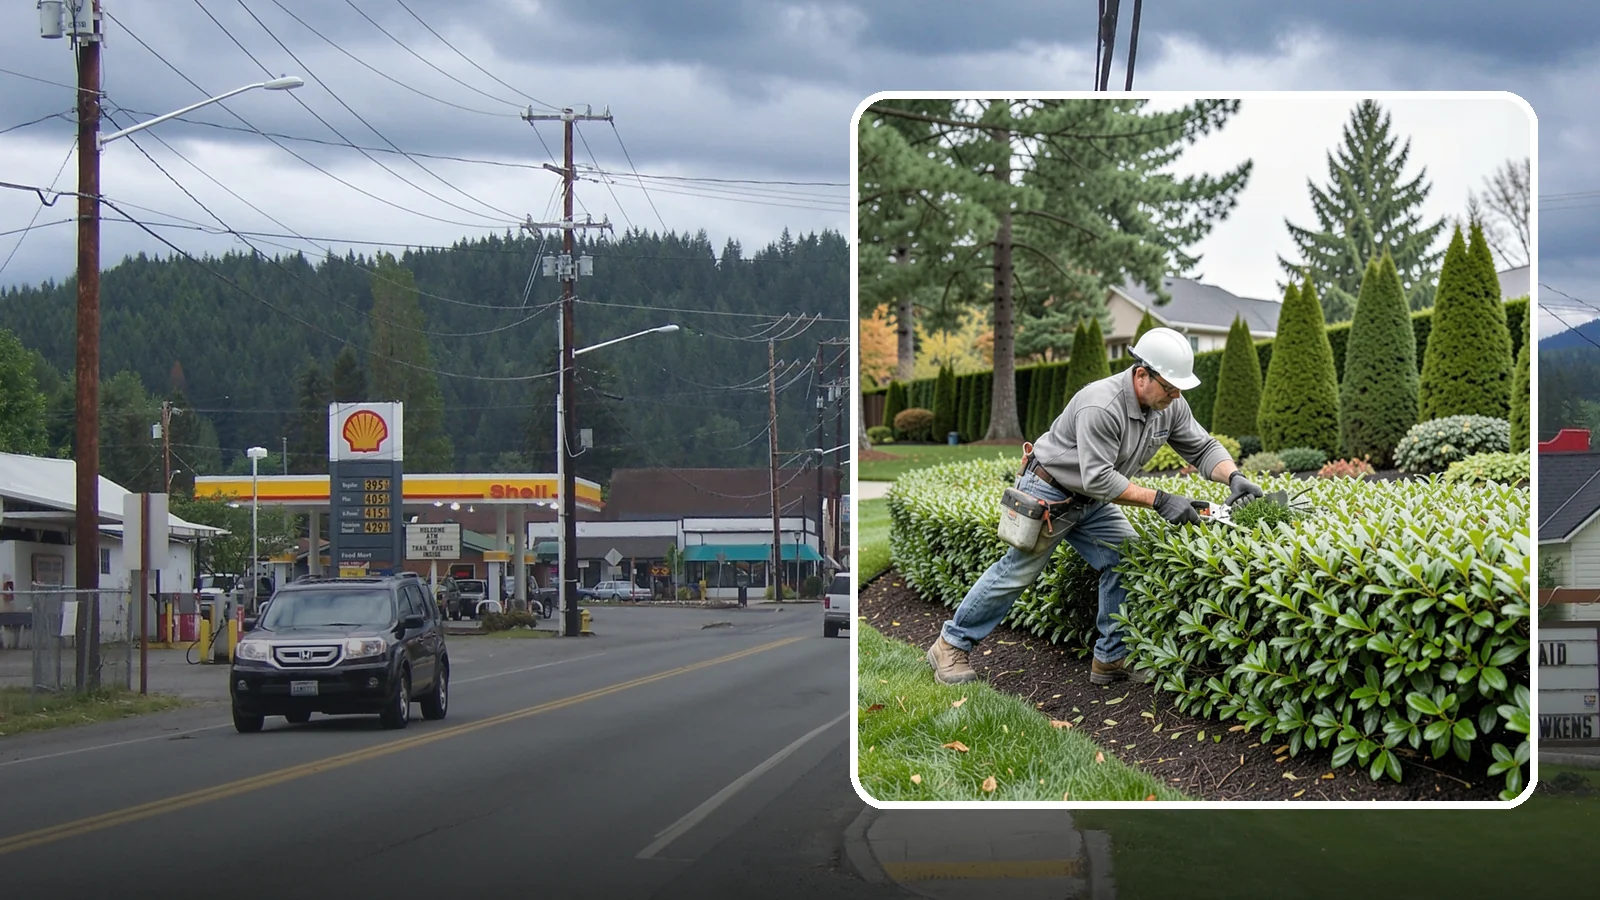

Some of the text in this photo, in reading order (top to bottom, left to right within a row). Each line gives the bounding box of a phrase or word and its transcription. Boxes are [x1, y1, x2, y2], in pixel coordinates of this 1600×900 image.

[366, 480, 383, 490] 395
[490, 484, 547, 498] Shell
[366, 494, 383, 504] 405
[366, 508, 383, 518] 415
[366, 522, 383, 532] 429
